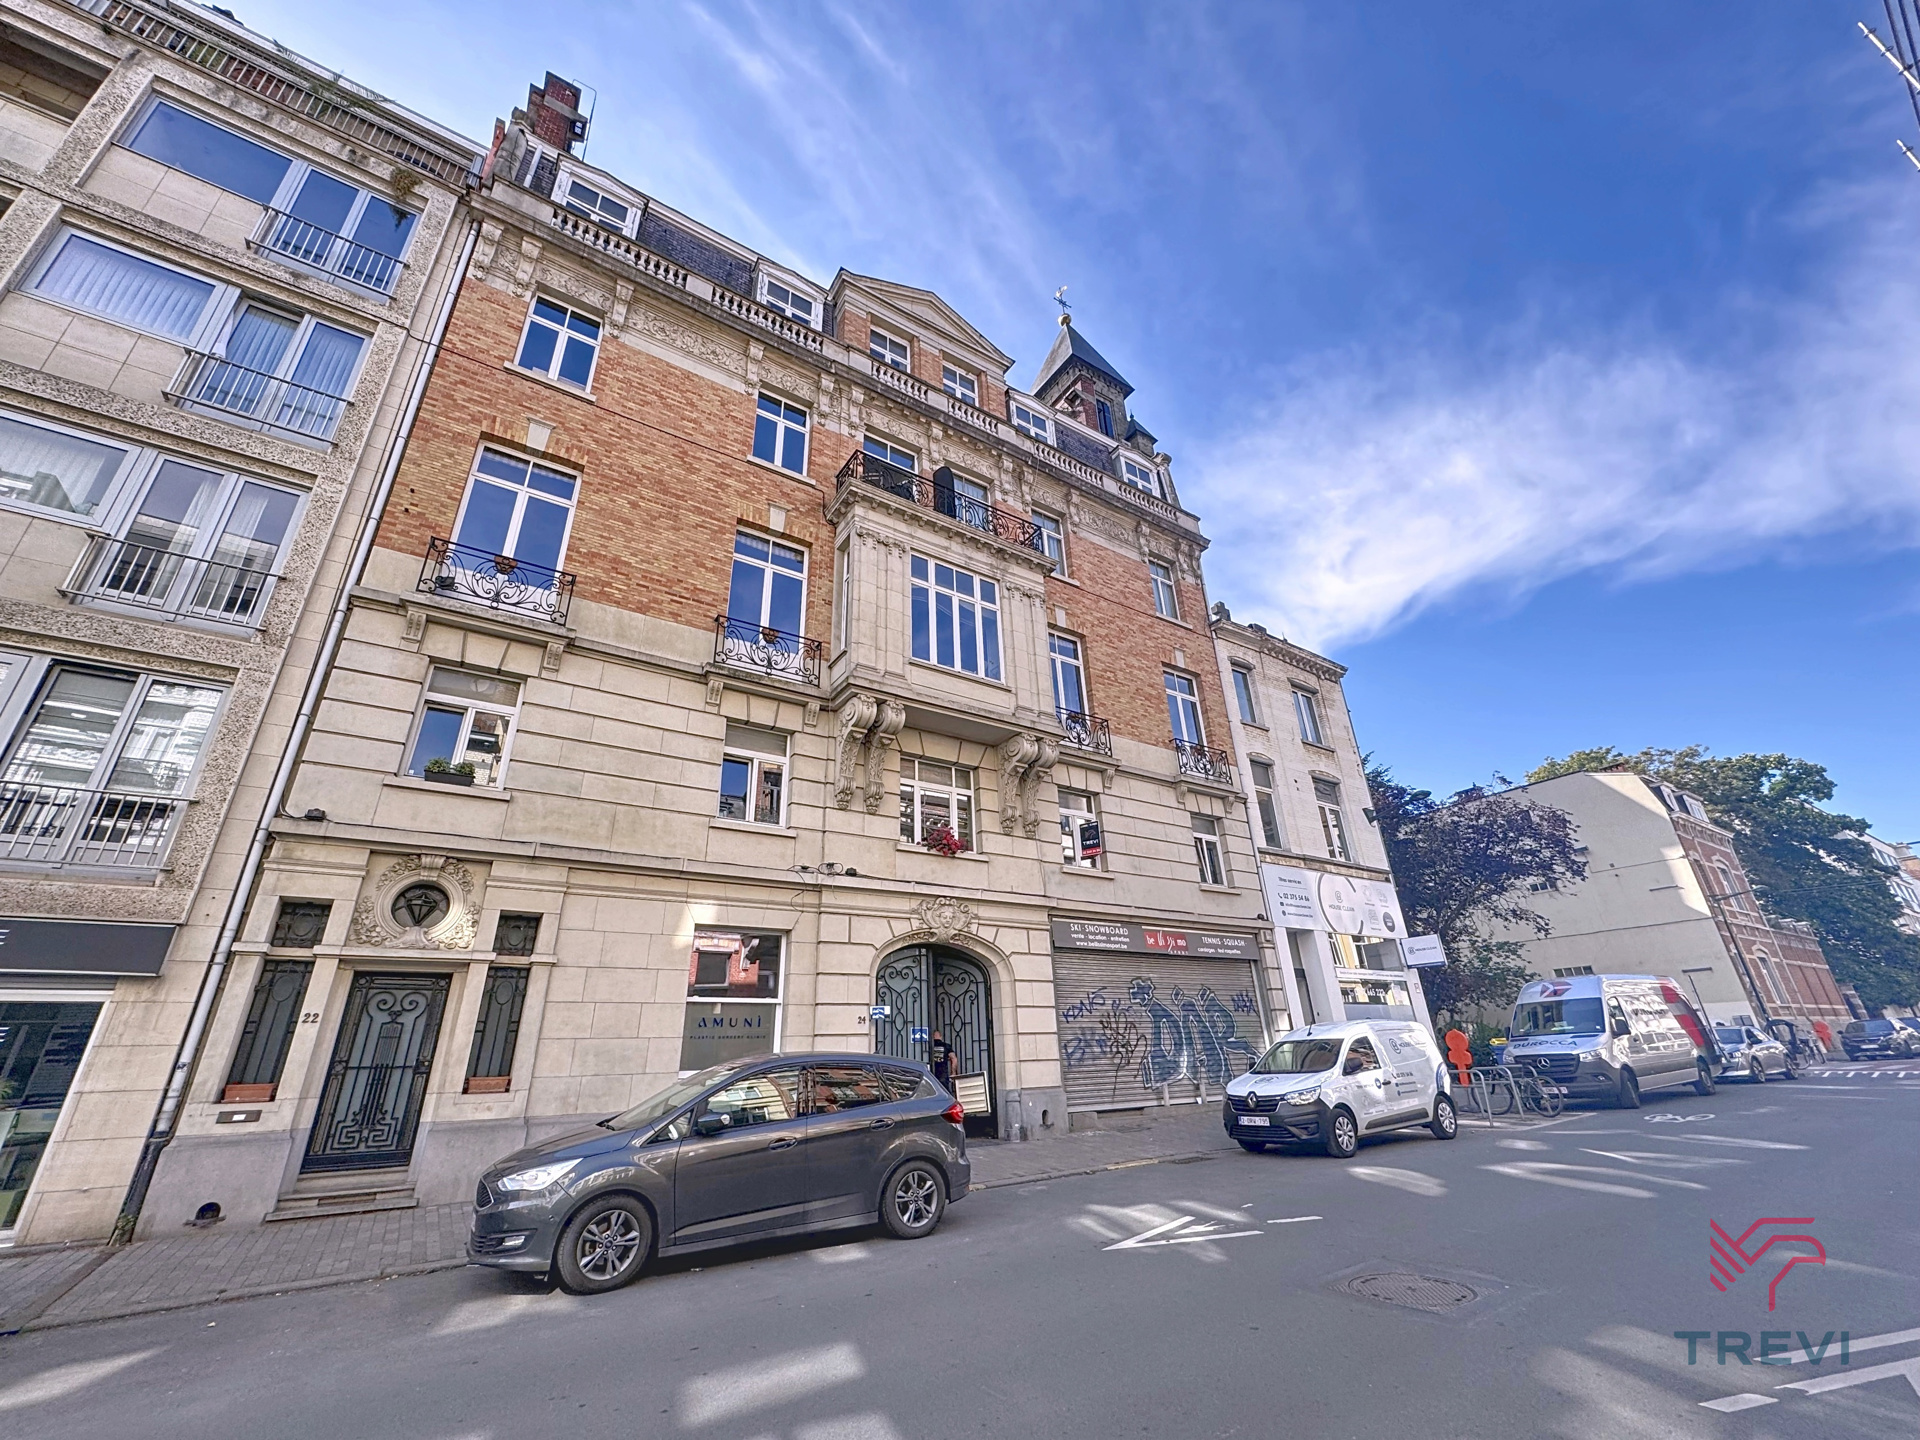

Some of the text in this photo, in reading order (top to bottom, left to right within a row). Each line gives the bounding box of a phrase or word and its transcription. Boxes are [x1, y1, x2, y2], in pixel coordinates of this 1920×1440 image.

[301, 1012, 320, 1024] 22
[857, 1016, 867, 1025] 24
[1513, 1040, 1578, 1050] DUROCCA
